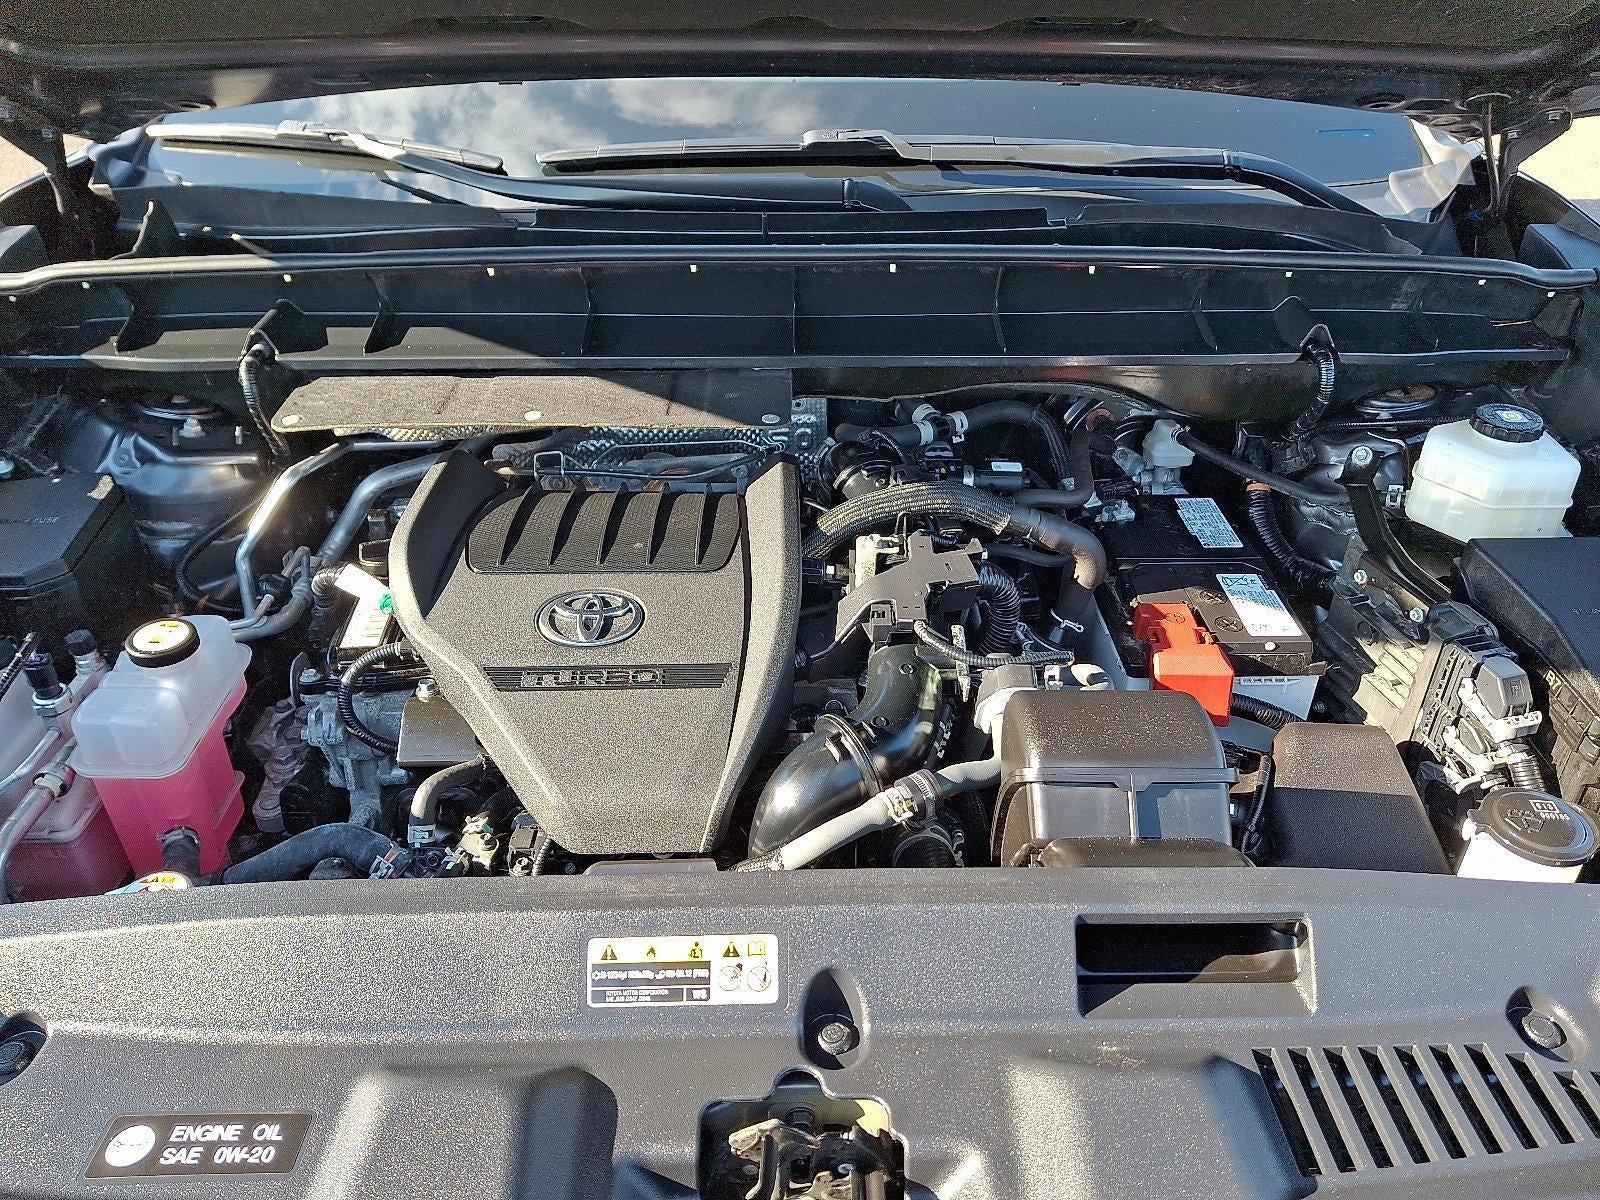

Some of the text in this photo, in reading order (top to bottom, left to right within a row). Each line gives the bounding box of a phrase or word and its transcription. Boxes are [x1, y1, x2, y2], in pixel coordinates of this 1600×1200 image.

[168, 1123, 283, 1142] ENGINE OIL
[159, 1146, 276, 1165] SAE 0W-20
